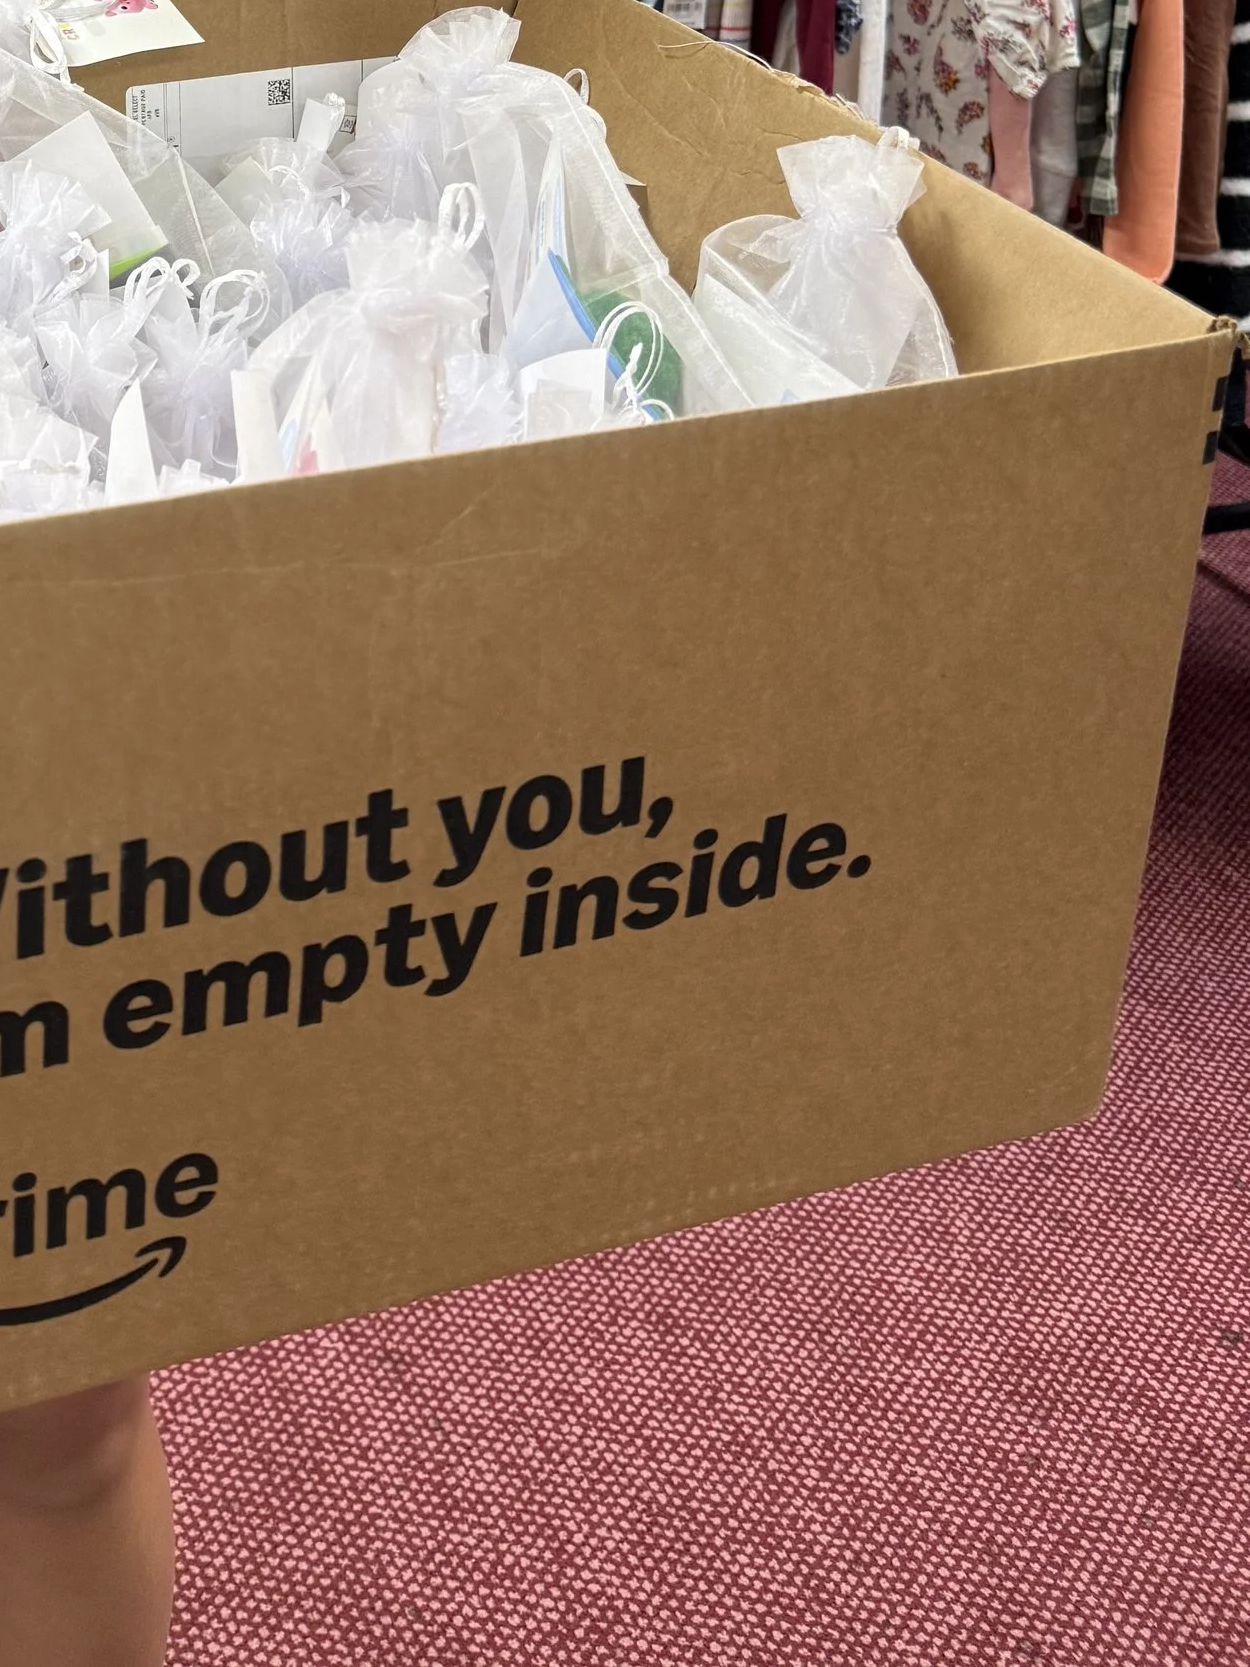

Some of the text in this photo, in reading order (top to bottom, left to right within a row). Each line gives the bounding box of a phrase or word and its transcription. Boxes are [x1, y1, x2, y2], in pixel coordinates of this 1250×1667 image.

[433, 755, 675, 888] you,
[102, 901, 499, 1050] empty
[519, 813, 874, 957] inside.
